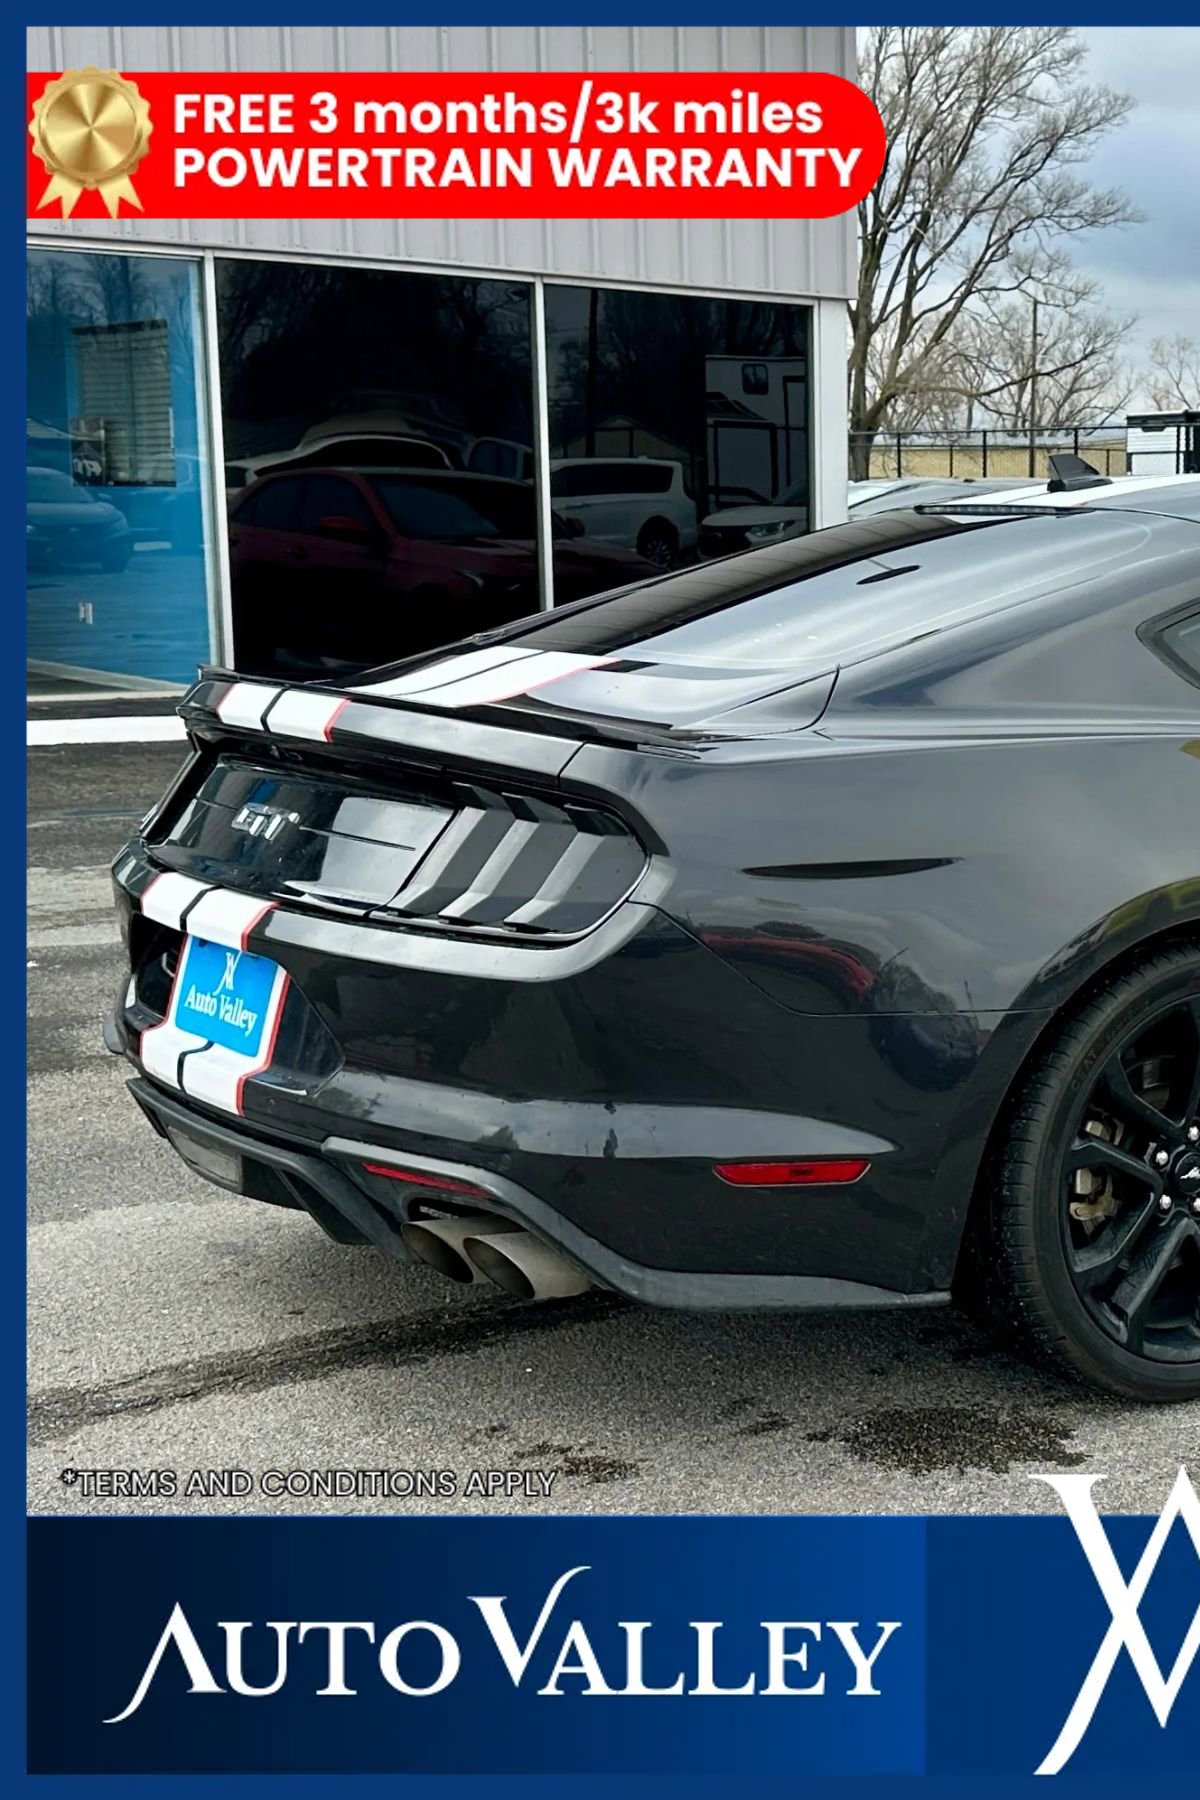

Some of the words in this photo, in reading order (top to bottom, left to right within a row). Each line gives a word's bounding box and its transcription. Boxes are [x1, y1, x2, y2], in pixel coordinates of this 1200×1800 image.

[231, 802, 301, 841] GT
[183, 983, 219, 1018] Auto
[218, 993, 259, 1038] Valley
